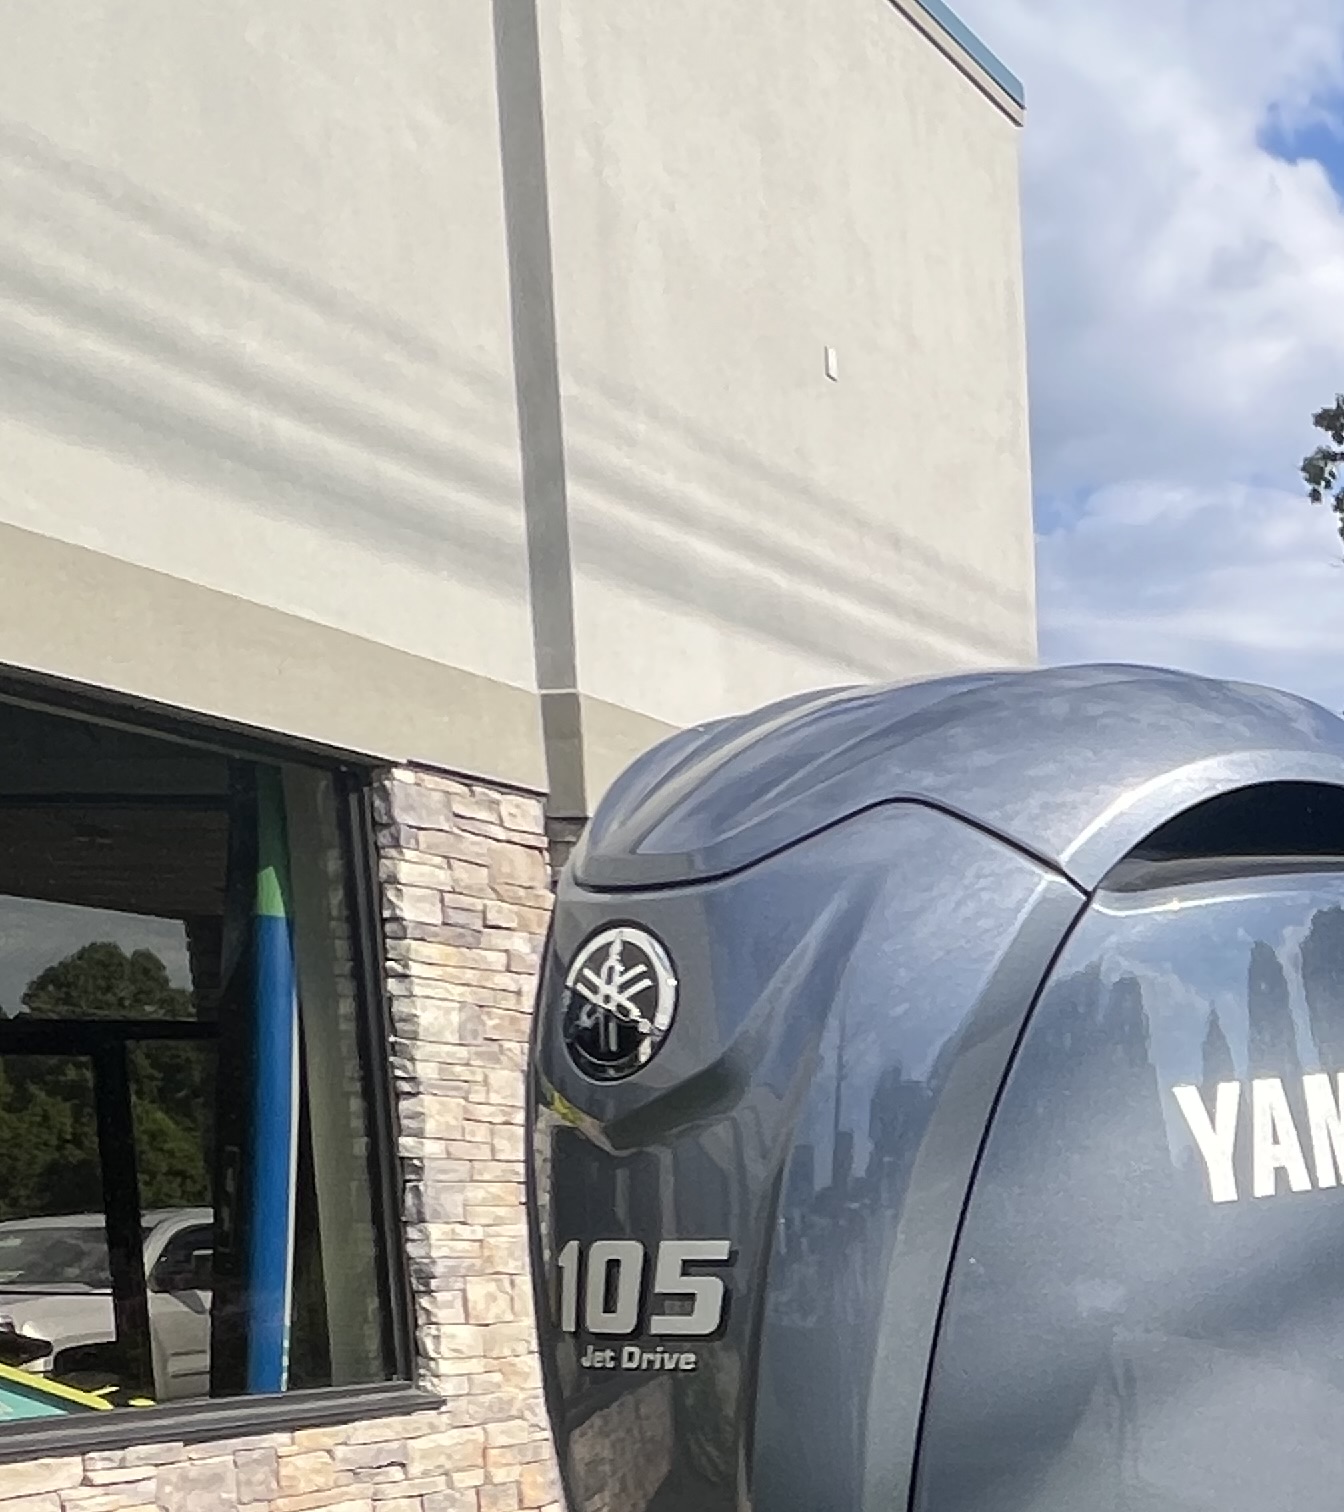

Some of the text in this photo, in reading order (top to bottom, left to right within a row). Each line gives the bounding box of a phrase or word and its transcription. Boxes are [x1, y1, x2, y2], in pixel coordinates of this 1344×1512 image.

[557, 1239, 732, 1336] 105
[580, 1344, 697, 1371] Jet Drive
